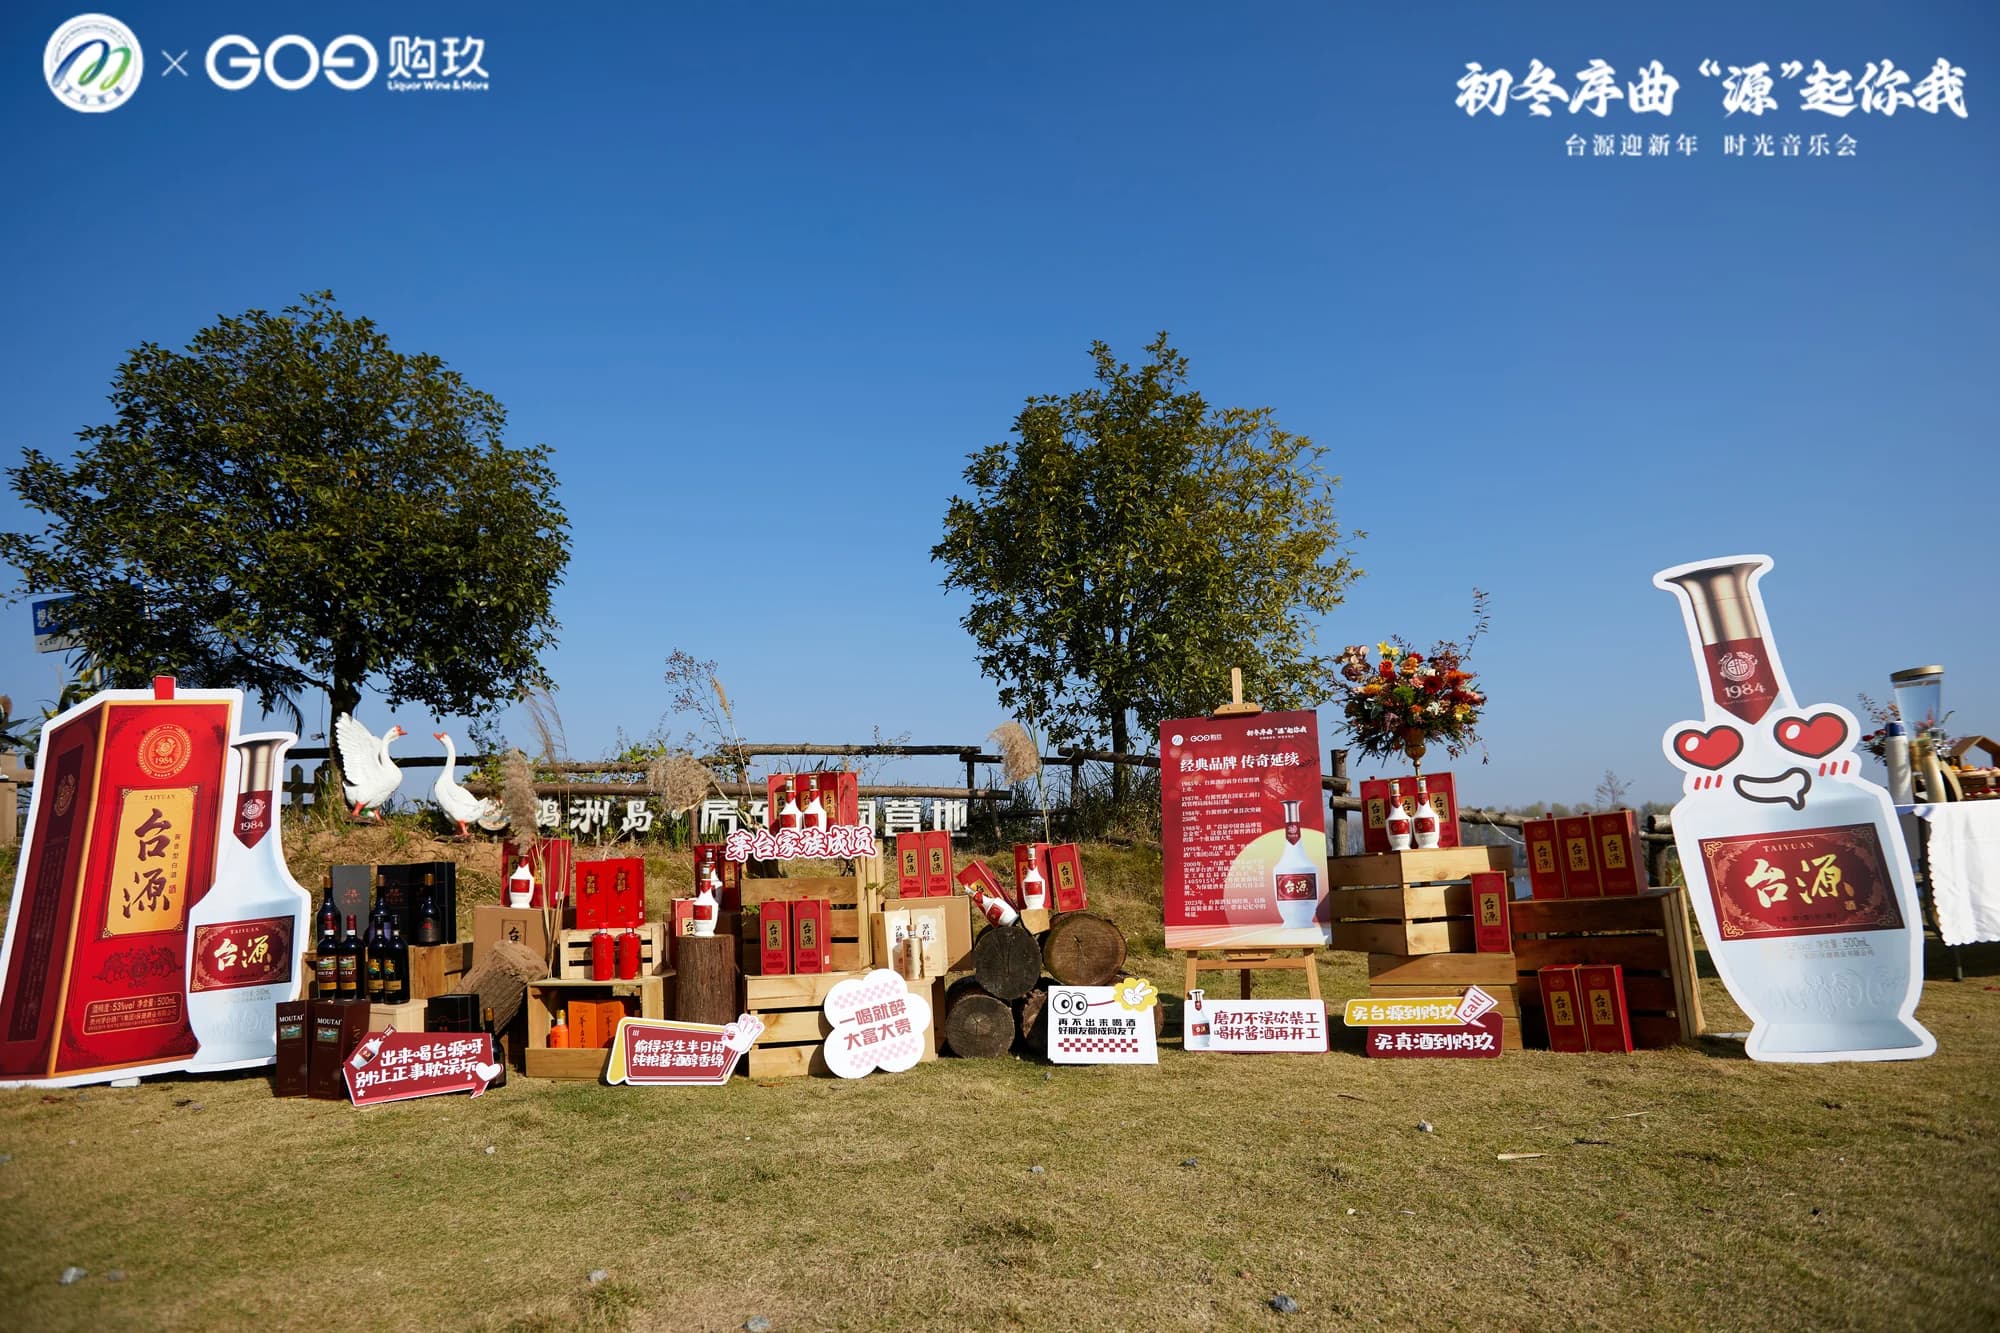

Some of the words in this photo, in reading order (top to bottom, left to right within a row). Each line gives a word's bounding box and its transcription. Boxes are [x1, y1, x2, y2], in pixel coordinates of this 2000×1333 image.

[1724, 682, 1767, 699] 1984
[1180, 755, 1237, 772] 经典品牌
[1240, 751, 1300, 769] 传奇延续
[240, 821, 264, 831] 1984
[1371, 803, 1384, 826] 台源
[726, 826, 876, 861] 茅台家族成员
[1608, 840, 1622, 865] 台源
[1762, 841, 1815, 853] TAIYUAN
[123, 808, 172, 919] 台源
[905, 852, 916, 874] 台源
[931, 851, 943, 873] 台源
[1537, 845, 1551, 870] 台源
[1572, 843, 1586, 868] 台源
[1061, 864, 1073, 887] 台源
[1284, 880, 1307, 894] 台源
[1744, 854, 1855, 909] 台源
[1484, 897, 1498, 923] 台源
[508, 926, 521, 942] 台
[768, 923, 780, 948] 台源
[802, 922, 814, 947] 台源
[214, 934, 271, 971] 台源
[839, 998, 907, 1025] 一喝就醉
[1214, 1010, 1320, 1025] 磨刀不误砍柴工
[1352, 1004, 1457, 1021] 买台源到购玖
[1462, 994, 1485, 1018] call
[1555, 995, 1570, 1022] 台源
[1594, 993, 1611, 1021] 台源
[279, 1014, 304, 1023] MOUTAI
[317, 1018, 342, 1026] MOUTAI
[1058, 1018, 1136, 1027] 再不出来喝酒
[843, 1018, 912, 1051] 大富大贵
[1058, 1027, 1136, 1035] 好朋友都成网友了
[1214, 1025, 1320, 1041] 喝杯酱酒再开工
[1374, 1032, 1496, 1051] 买真酒到购玖
[380, 1038, 483, 1067] 出来喝台源呀
[634, 1039, 725, 1053] 偷得浮生半日闲
[632, 1053, 725, 1068] 纯粮酱酒醇香绵
[355, 1056, 478, 1089] 别让正事耽误玩
